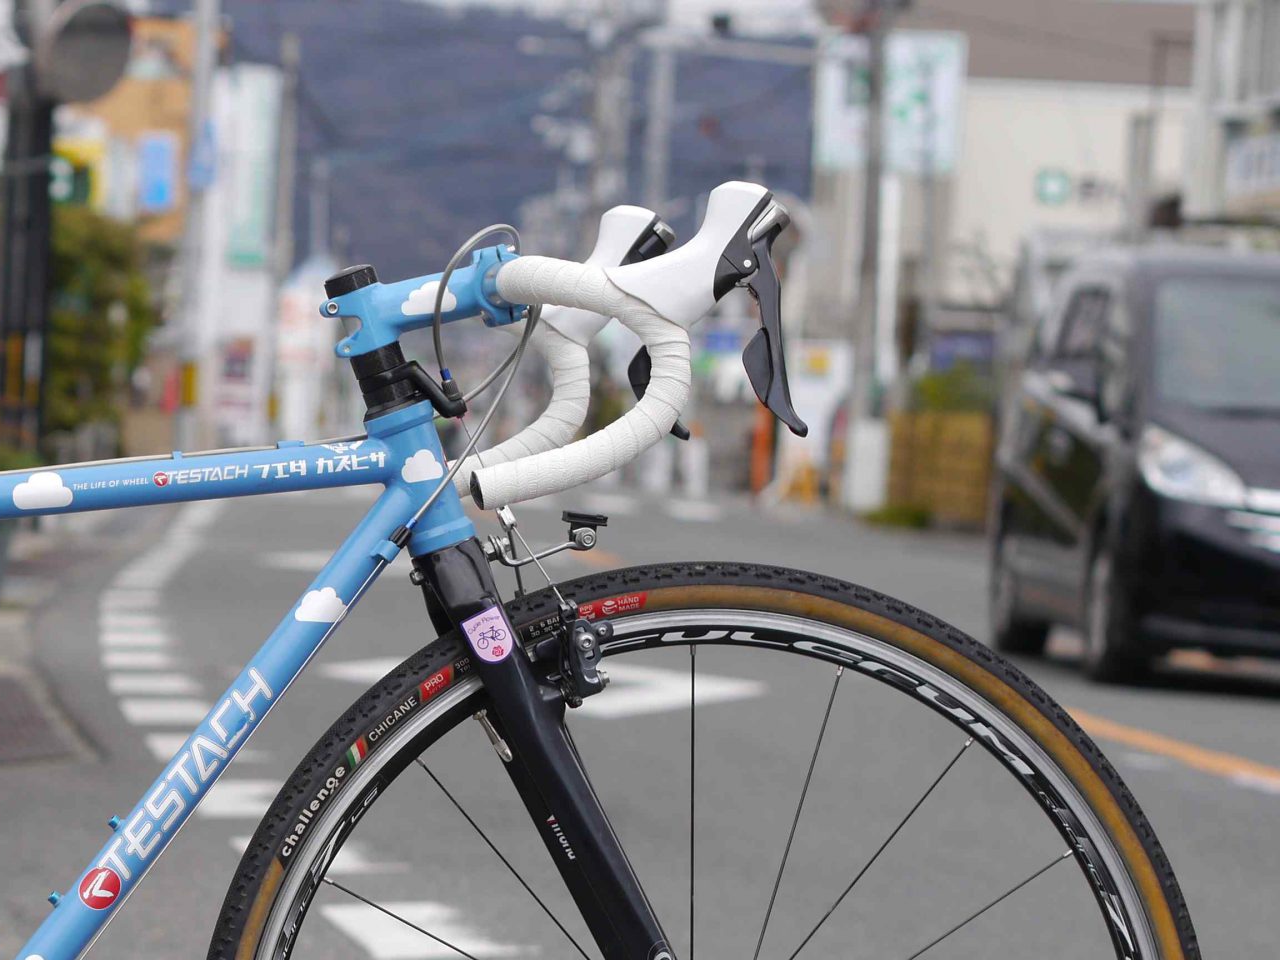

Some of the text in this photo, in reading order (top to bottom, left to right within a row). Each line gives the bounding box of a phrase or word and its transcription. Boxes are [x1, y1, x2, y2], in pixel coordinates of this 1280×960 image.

[167, 464, 249, 485] TESTACH
[73, 477, 150, 491] THE LIFE OF WHEEL
[617, 596, 640, 606] HAND
[618, 603, 641, 612] MADE
[454, 657, 470, 669] 300
[423, 673, 444, 691] PRO
[368, 696, 418, 742] CHICANE
[97, 667, 274, 882] TESTACH
[282, 766, 346, 857] challenge
